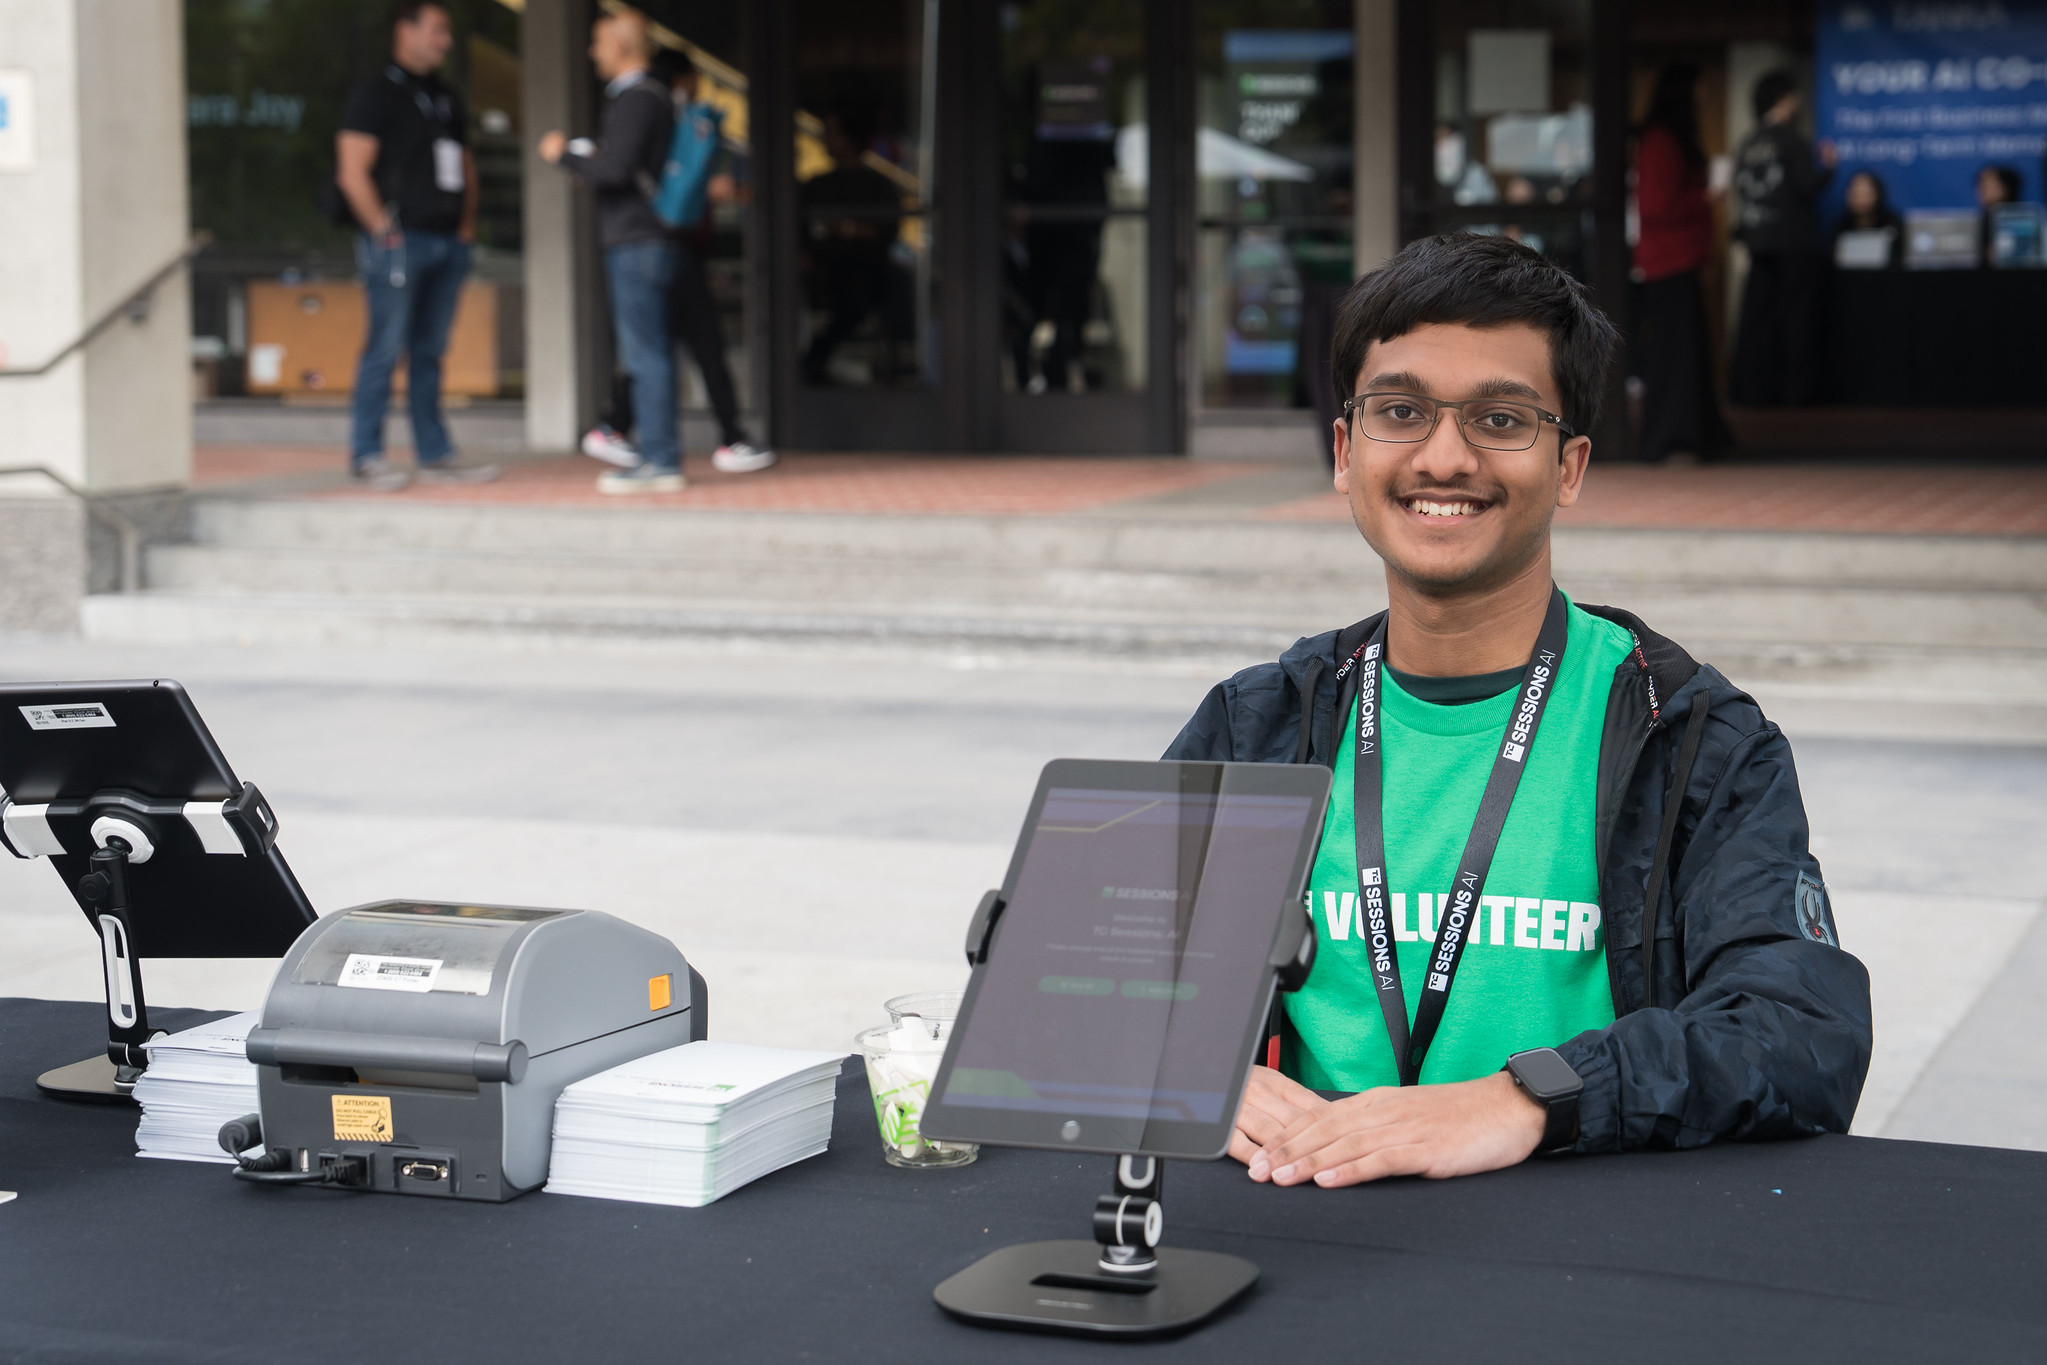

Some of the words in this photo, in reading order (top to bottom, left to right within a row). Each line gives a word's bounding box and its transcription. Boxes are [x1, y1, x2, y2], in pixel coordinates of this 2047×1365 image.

[1833, 60, 1929, 94] YOUR
[1975, 55, 2047, 91] CO-
[1361, 661, 1377, 738] SESSIONS
[1511, 665, 1550, 743] SESSIONS
[1539, 649, 1556, 667] AI
[1360, 740, 1374, 755] AI
[1116, 888, 1179, 901] SESSIONS
[1435, 889, 1473, 973] SESSIONS
[1461, 871, 1479, 891] AI
[1366, 887, 1391, 973] SESSIONS
[1379, 975, 1395, 991] AI
[344, 1099, 379, 1107] ATTENTION
